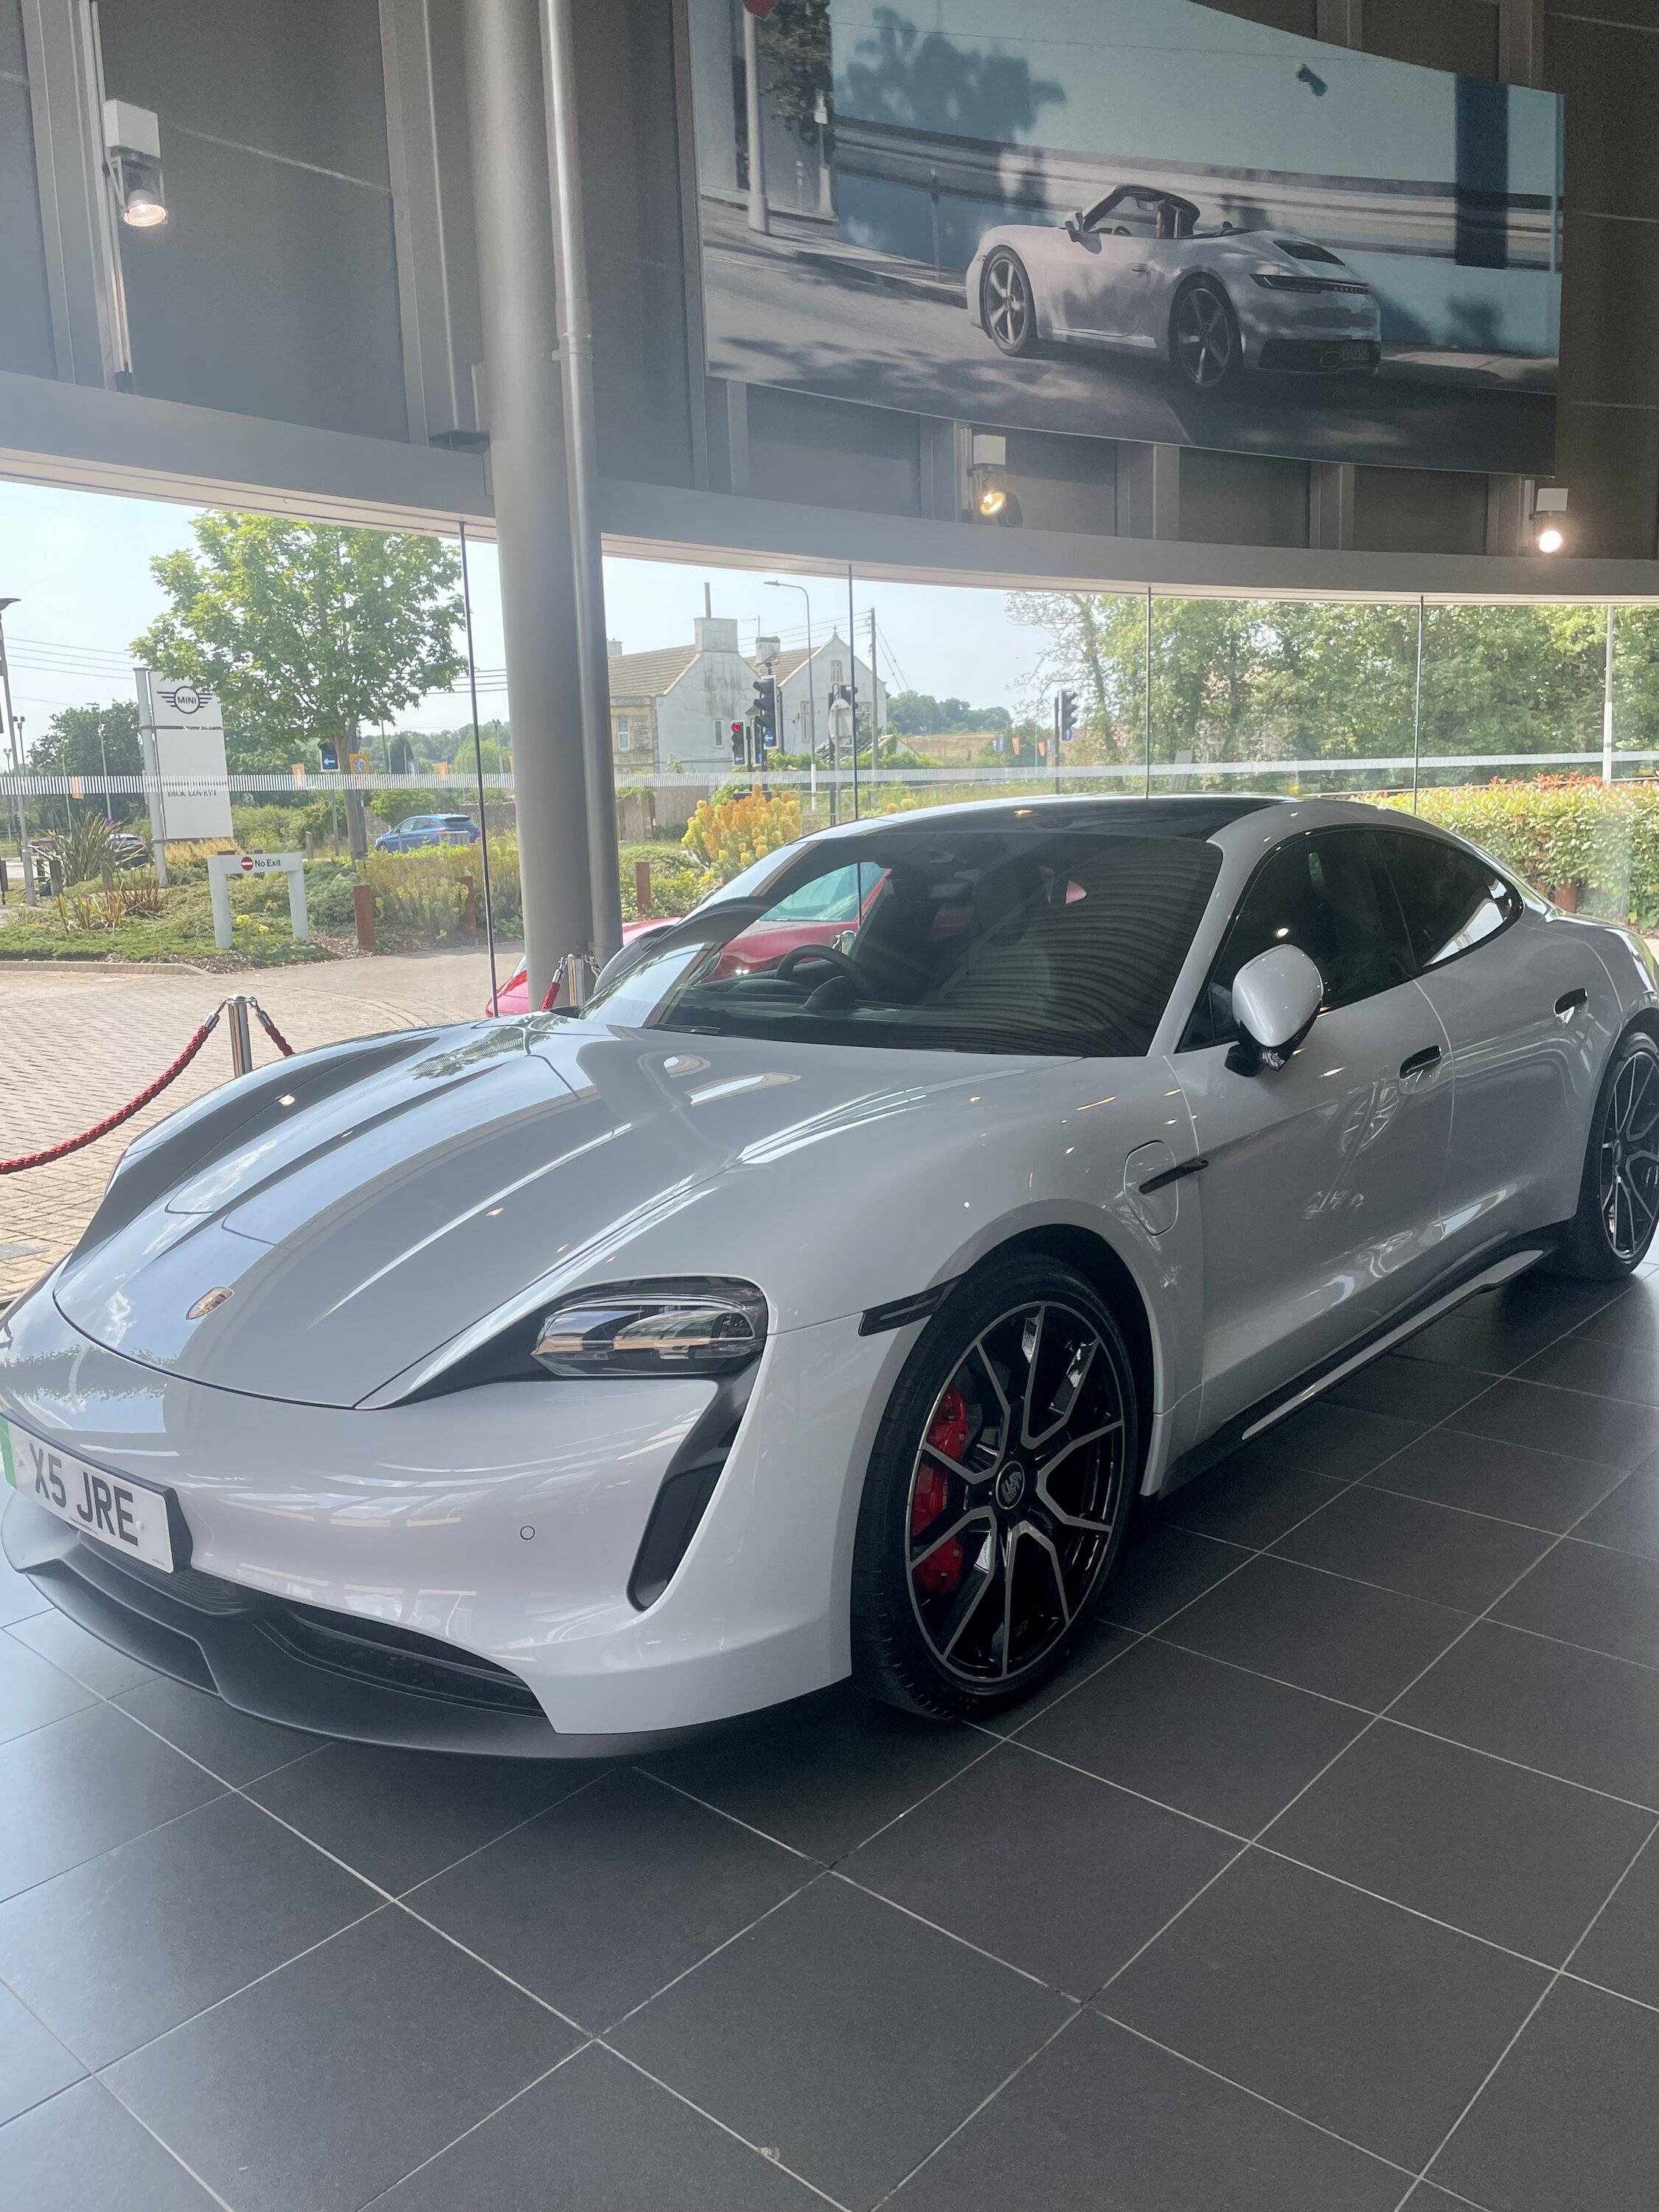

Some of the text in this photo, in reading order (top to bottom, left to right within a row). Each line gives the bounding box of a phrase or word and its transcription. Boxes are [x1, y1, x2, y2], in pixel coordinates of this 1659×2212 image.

[254, 858, 281, 867] No Exit
[29, 1442, 139, 1547] X5 JRE
